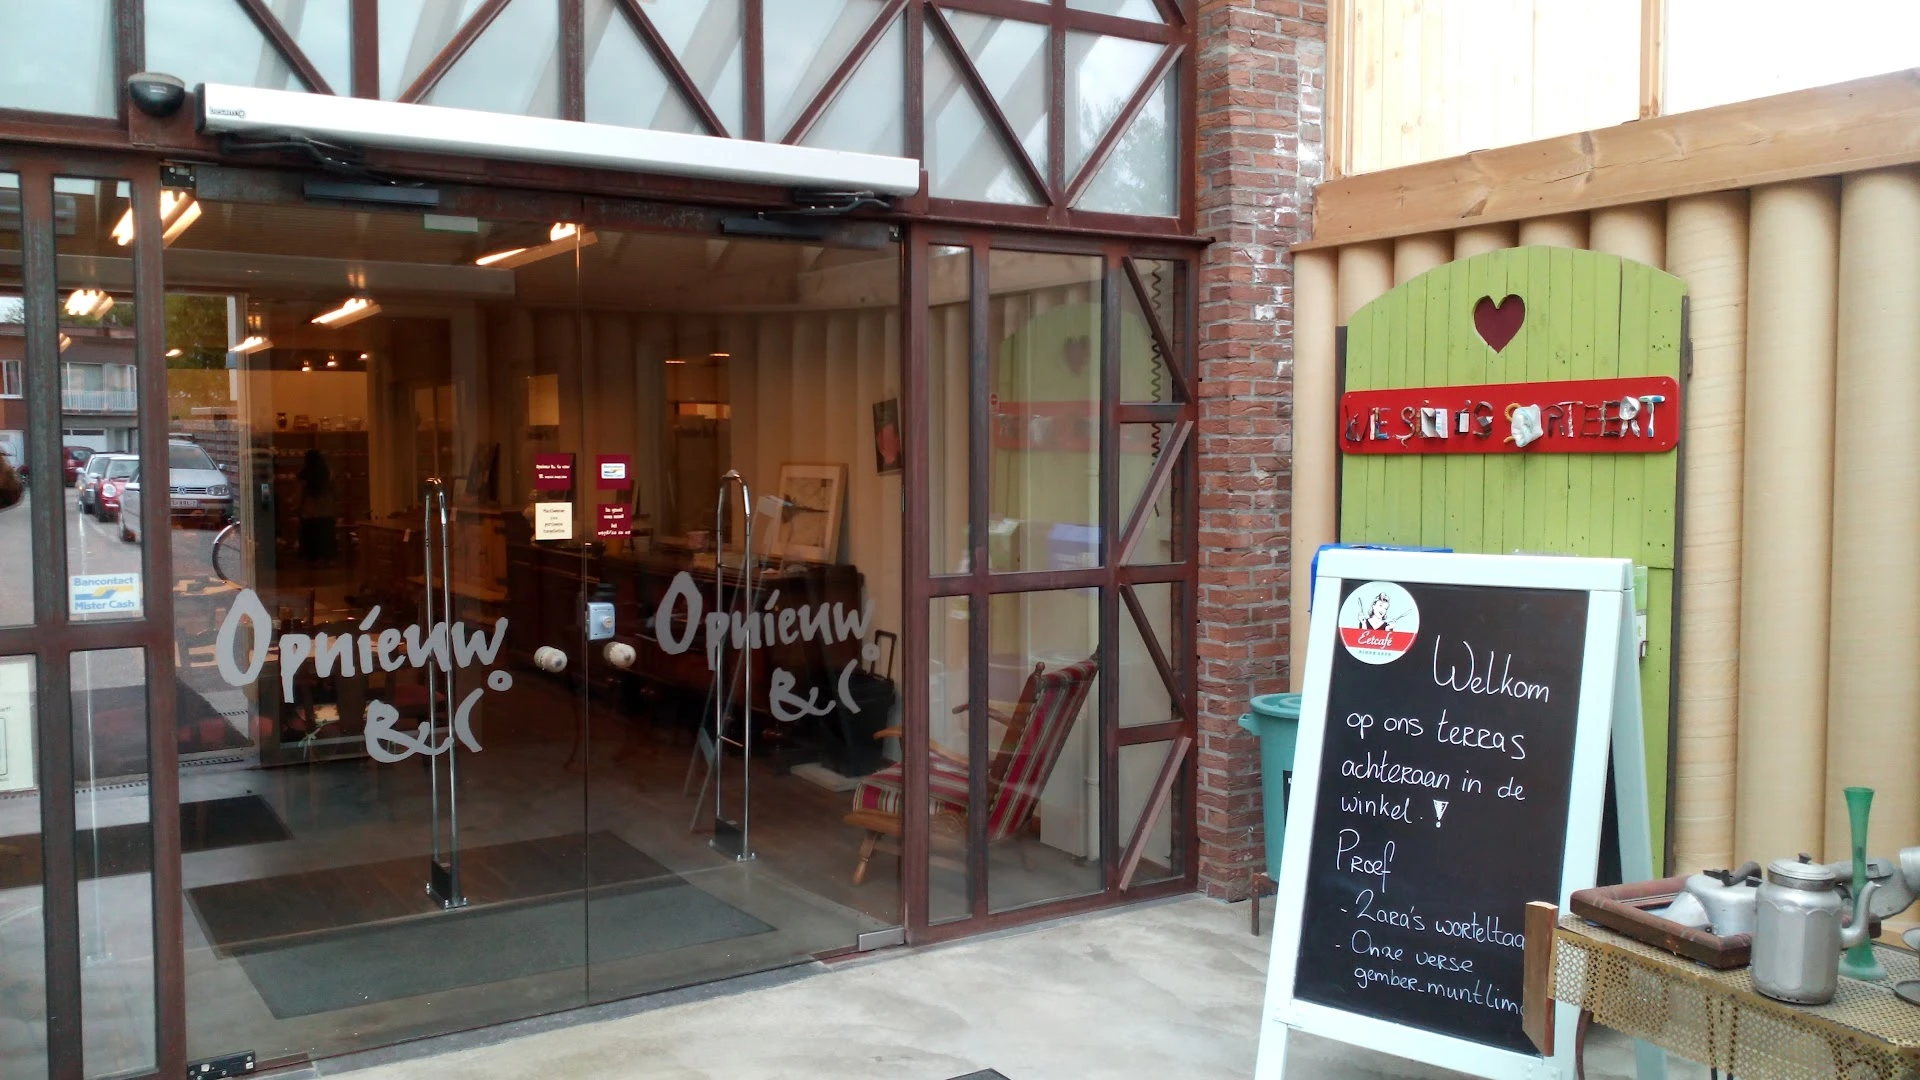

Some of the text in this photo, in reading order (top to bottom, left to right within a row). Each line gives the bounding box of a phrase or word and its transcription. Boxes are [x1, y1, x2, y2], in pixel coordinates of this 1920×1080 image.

[73, 576, 134, 587] Bancontact
[74, 600, 135, 611] Mister Cash
[1357, 630, 1393, 650] Eetcafé
[1434, 635, 1549, 702] Welkom
[363, 698, 455, 763] &
[1347, 713, 1373, 739] op
[1384, 718, 1423, 736] ons
[1342, 751, 1525, 800] achteraan in de
[1337, 829, 1395, 893] Proef
[1352, 930, 1403, 960] Onze
[1416, 952, 1472, 972] verse
